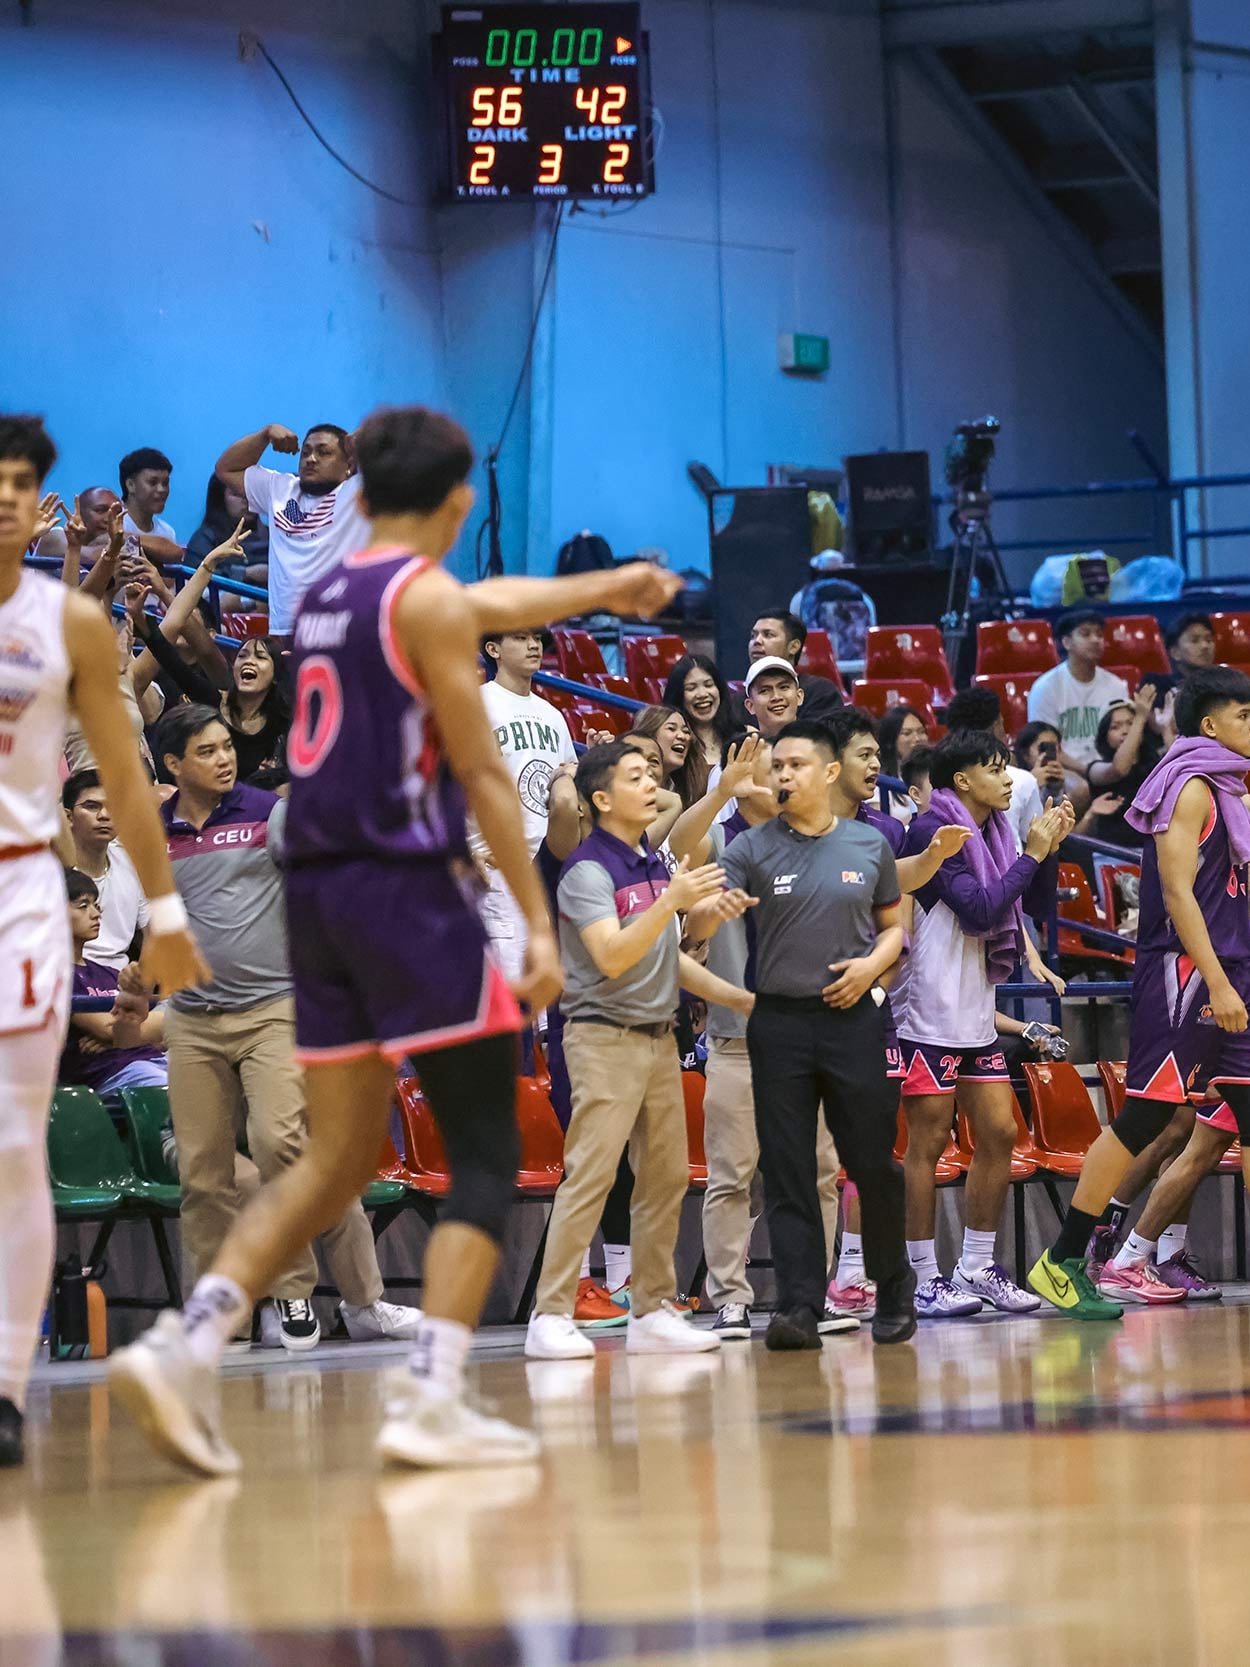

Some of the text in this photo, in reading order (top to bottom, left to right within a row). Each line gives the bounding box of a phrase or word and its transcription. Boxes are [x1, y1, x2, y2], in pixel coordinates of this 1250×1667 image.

[486, 28, 603, 67] 00.00
[510, 68, 581, 83] TIME
[471, 86, 523, 126] 56
[575, 86, 627, 124] 42
[467, 127, 529, 142] DARK
[564, 125, 637, 141] LIGHT
[469, 145, 496, 185] 2
[538, 144, 563, 184] 3
[603, 143, 630, 183] 2
[287, 654, 345, 779] 0
[212, 828, 253, 845] CEU
[975, 1052, 1008, 1071] CE
